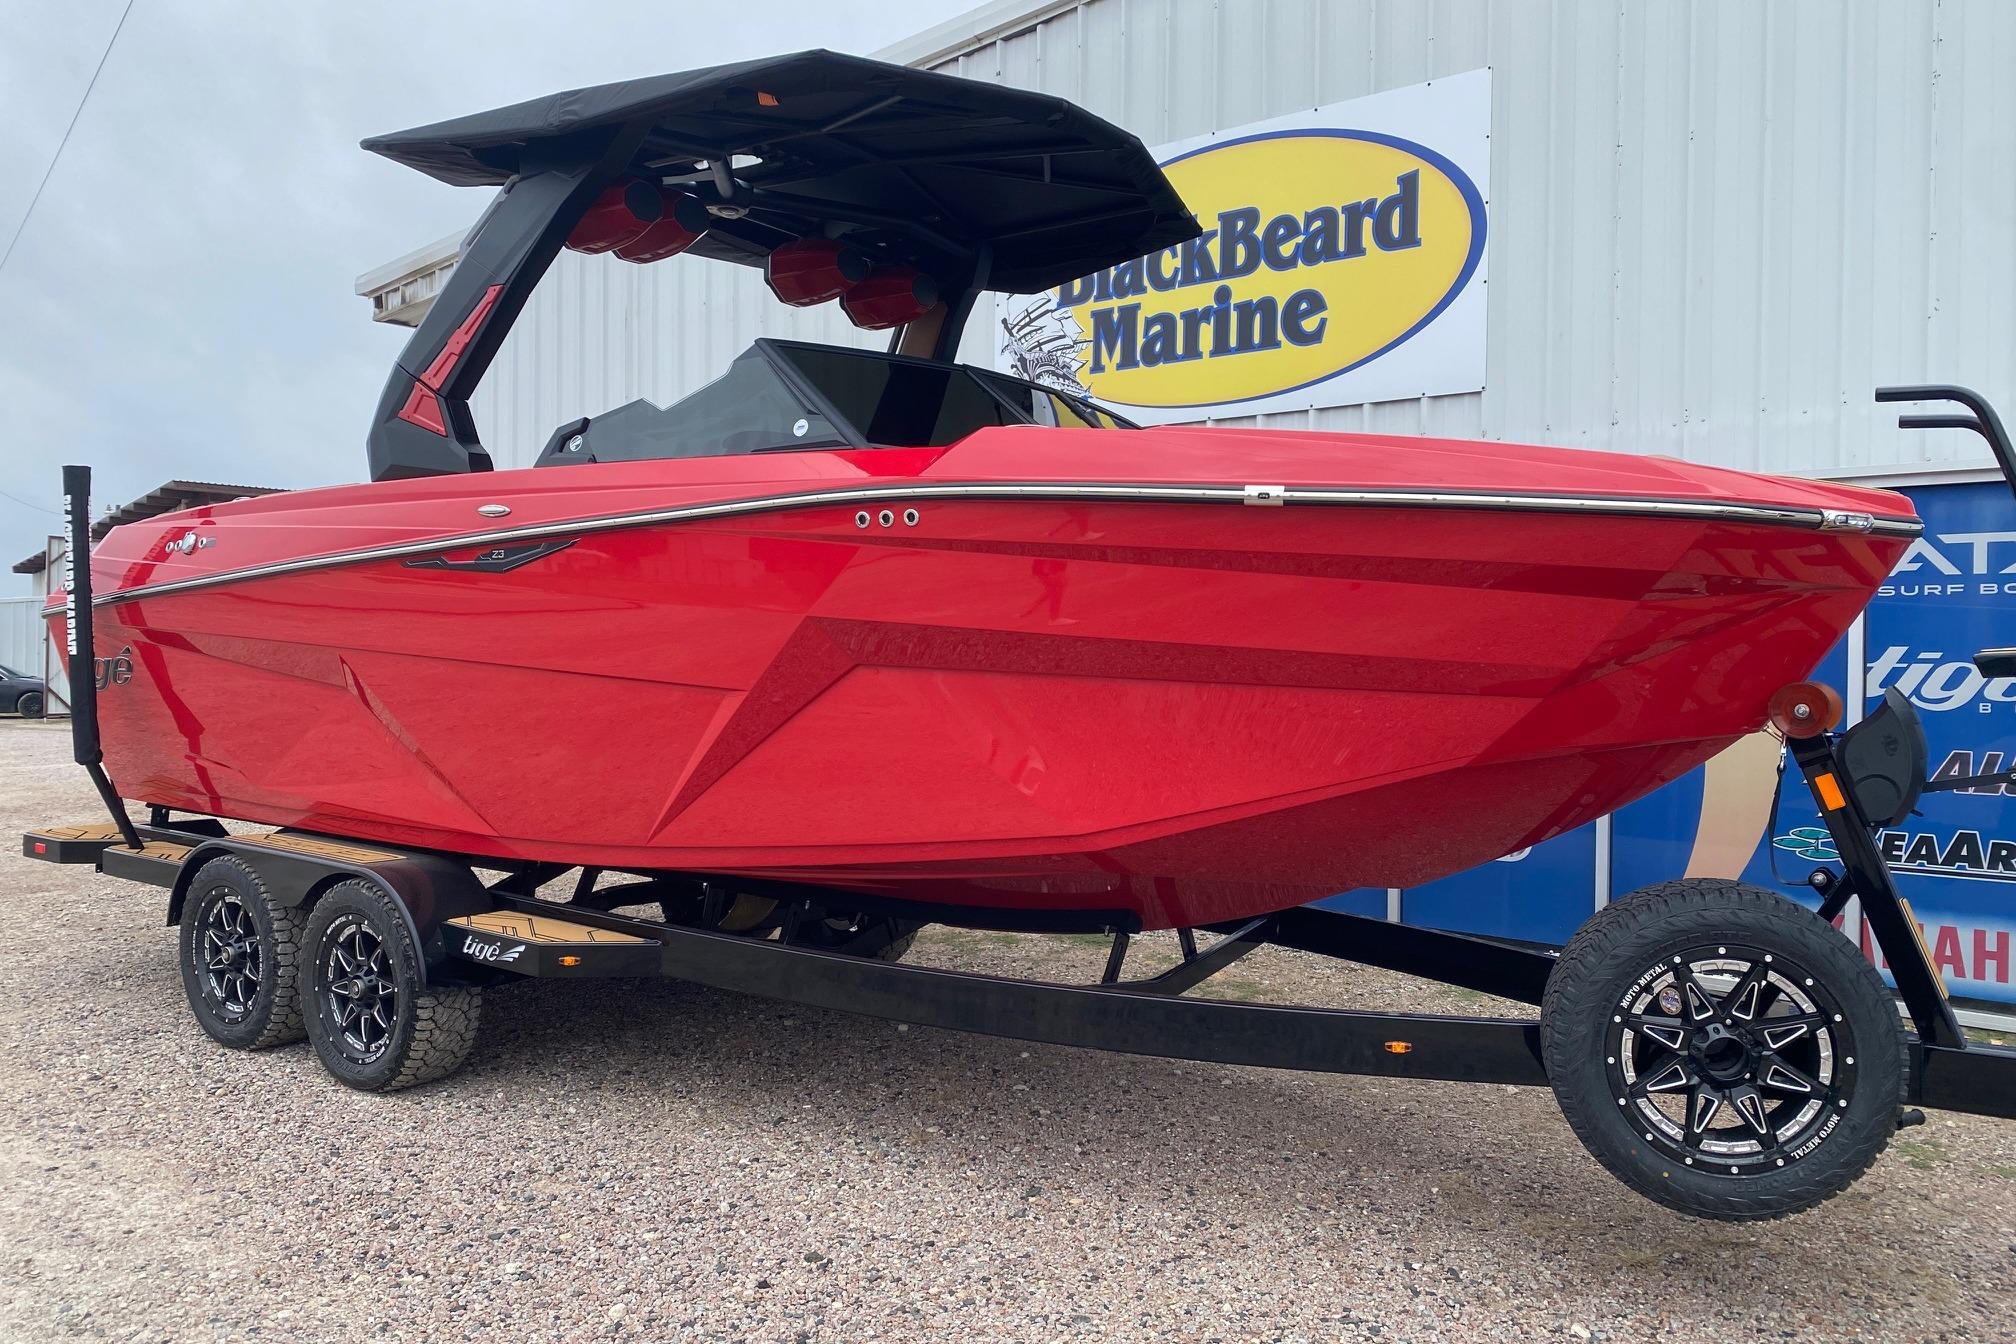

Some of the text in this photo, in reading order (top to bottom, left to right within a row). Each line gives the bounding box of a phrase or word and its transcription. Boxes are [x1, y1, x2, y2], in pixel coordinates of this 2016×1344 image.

[1090, 284, 1329, 374] Marine
[1888, 531, 2016, 577] AT
[1877, 584, 1965, 597] SURF
[1929, 750, 2016, 797] AL
[1876, 828, 2016, 873] EAAR
[462, 935, 501, 962] tigé
[1620, 963, 1668, 1009] MOTO METAL
[1790, 1113, 1841, 1160] MOTO METAL
